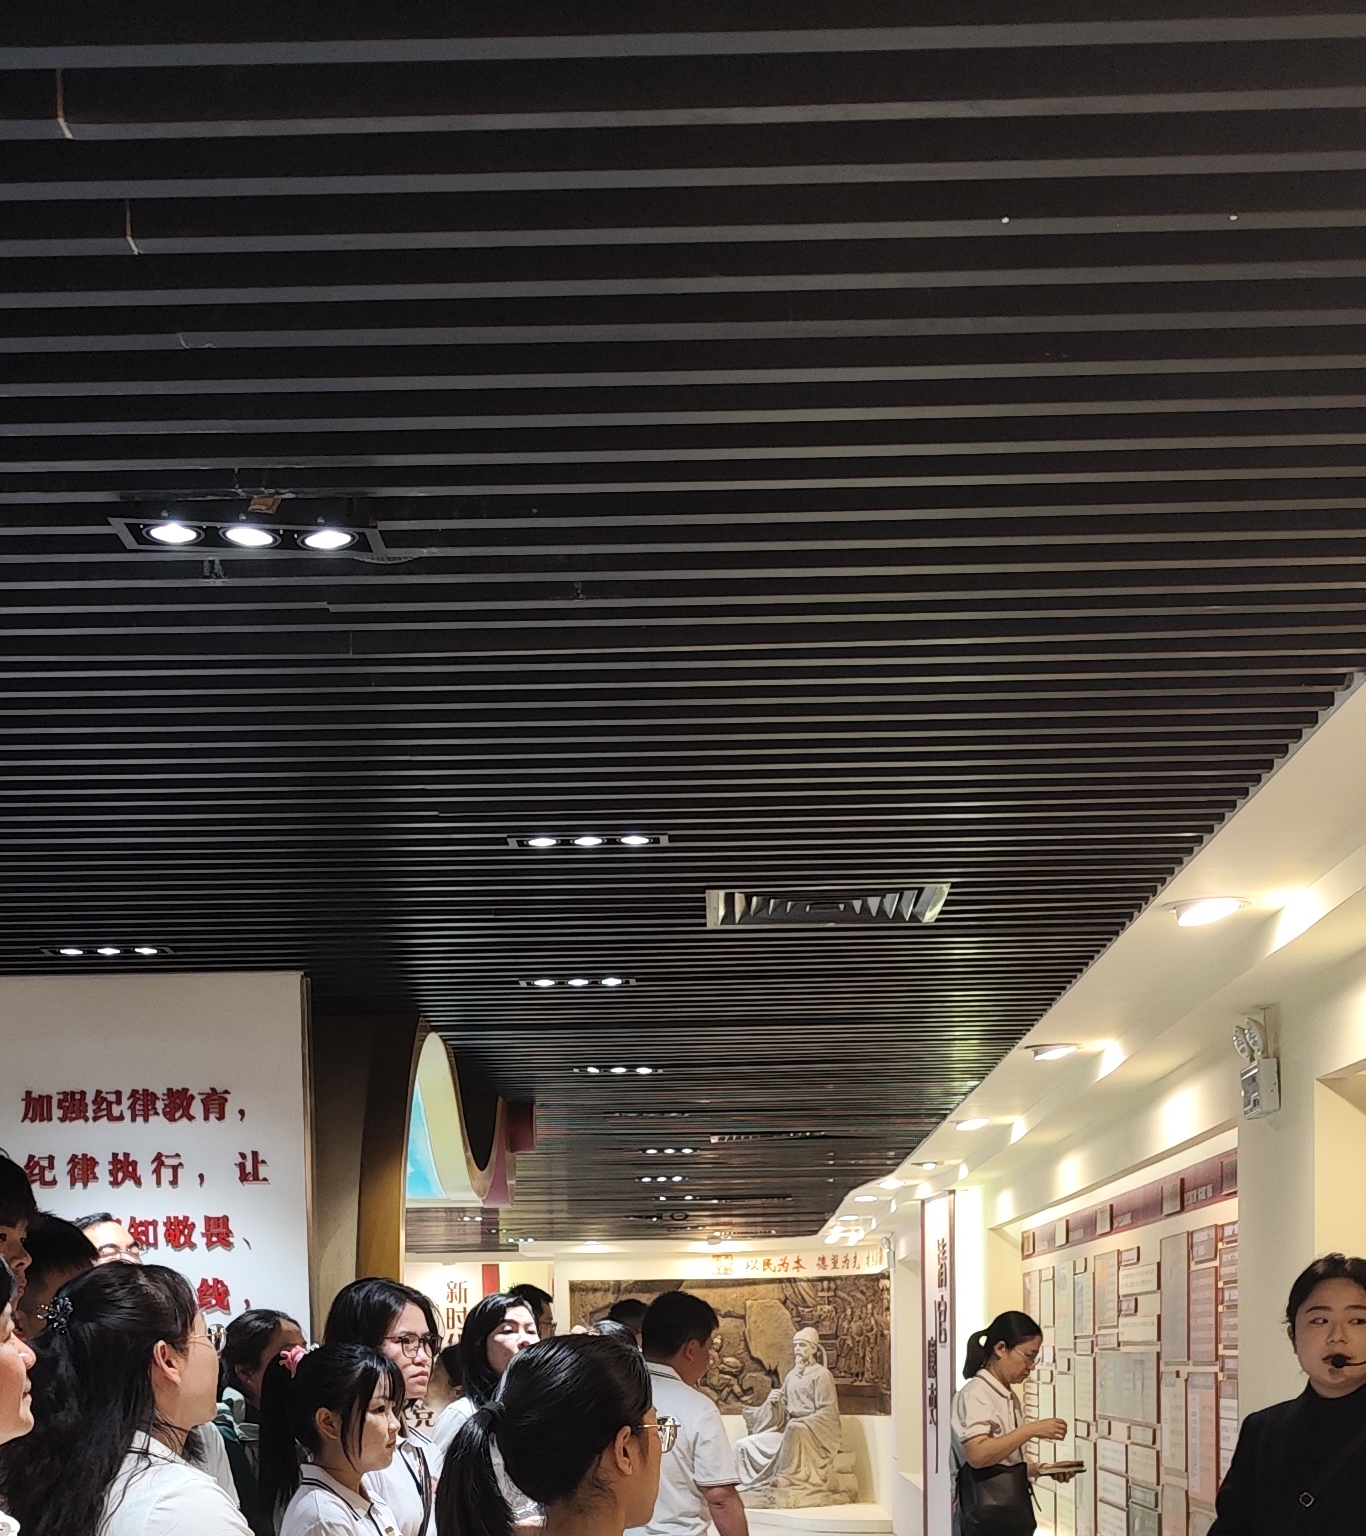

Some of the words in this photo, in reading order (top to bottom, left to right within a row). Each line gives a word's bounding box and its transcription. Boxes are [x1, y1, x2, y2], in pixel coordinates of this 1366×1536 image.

[21, 1088, 249, 1124] 加强纪律教育，
[24, 1151, 270, 1189] 纪律执行，让
[113, 1215, 252, 1251] 知敬畏、
